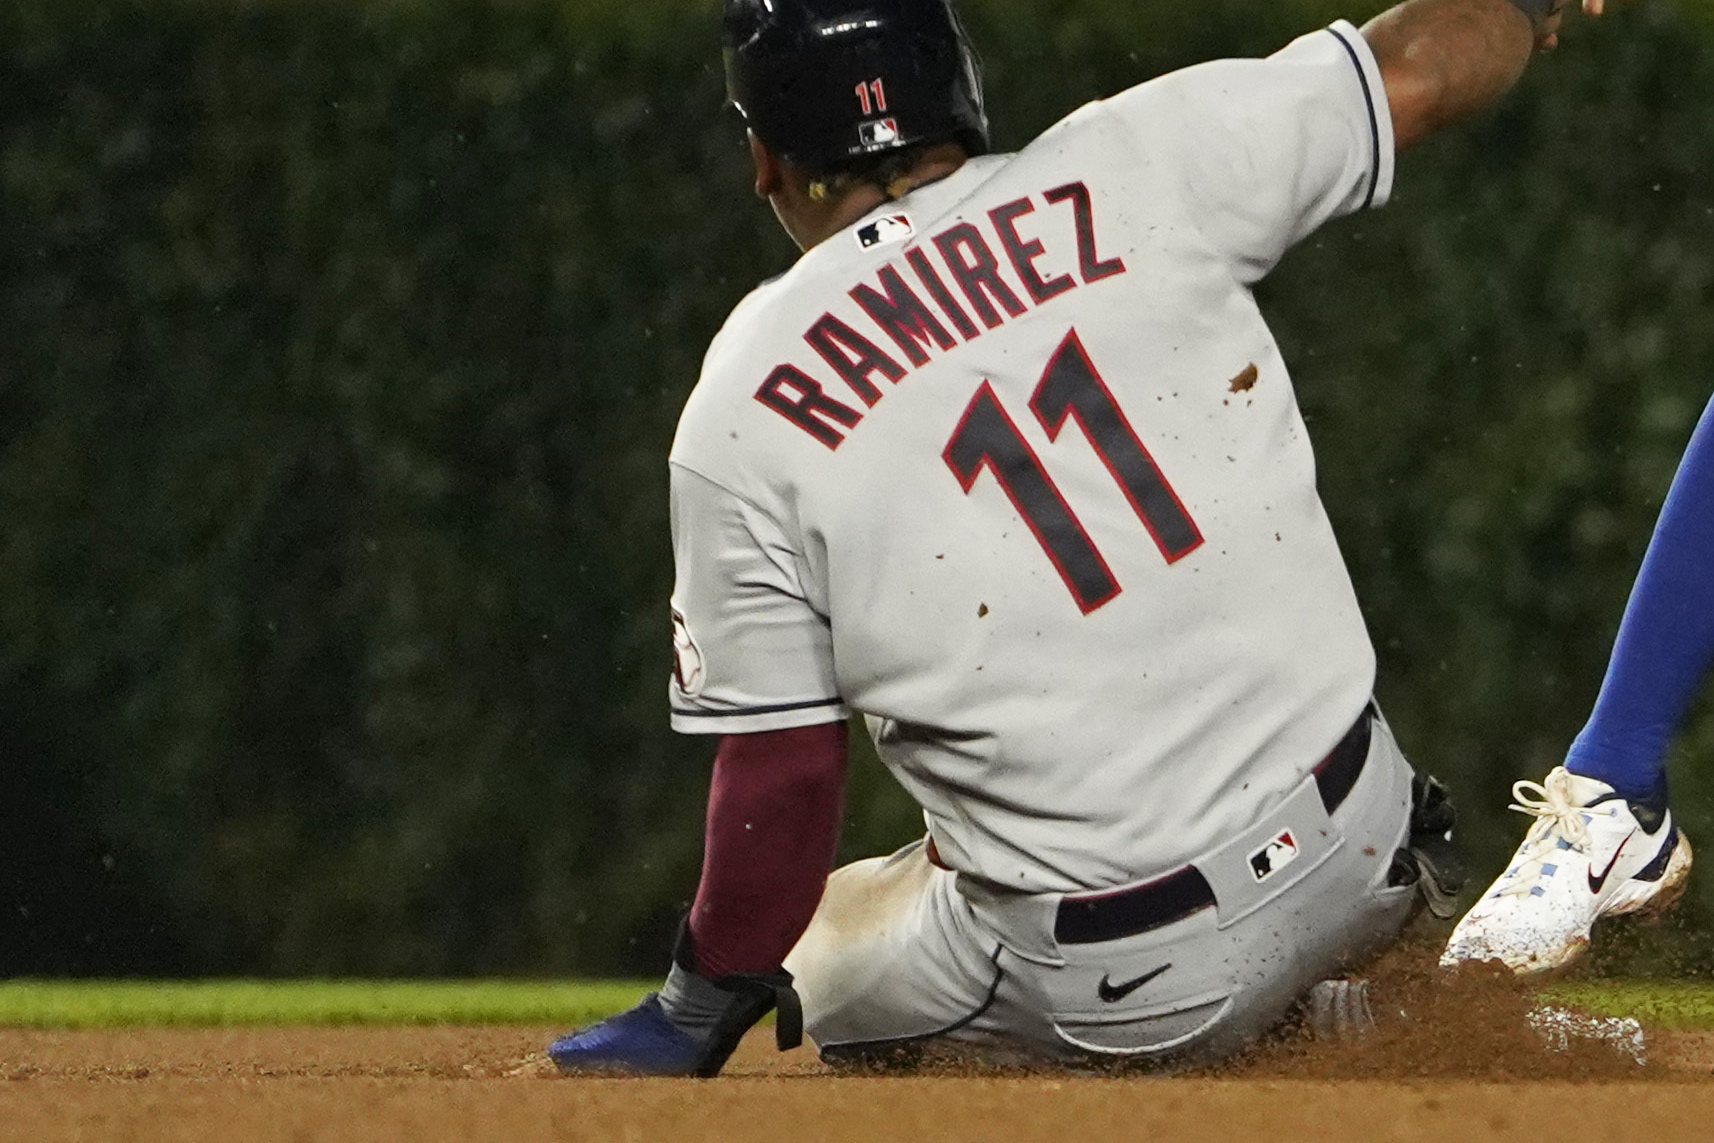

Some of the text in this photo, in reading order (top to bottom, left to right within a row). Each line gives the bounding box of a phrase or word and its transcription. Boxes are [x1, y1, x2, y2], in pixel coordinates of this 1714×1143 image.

[855, 77, 887, 115] 11
[752, 180, 1127, 452] RAMIREZ
[941, 326, 1206, 617] 11
